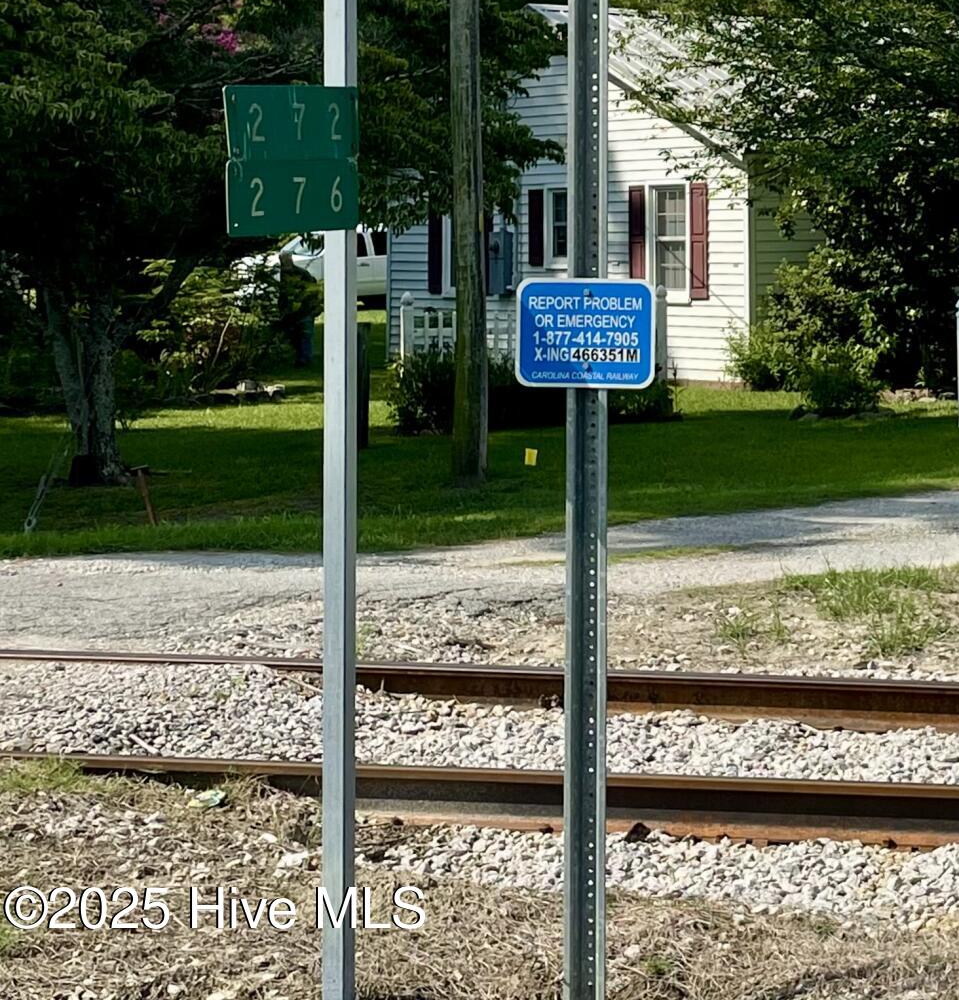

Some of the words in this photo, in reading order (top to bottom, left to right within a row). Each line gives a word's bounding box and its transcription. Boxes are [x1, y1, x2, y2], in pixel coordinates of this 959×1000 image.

[249, 102, 342, 142] 272
[250, 176, 343, 217] 276
[528, 296, 581, 310] REPORT
[583, 297, 642, 311] PROBLEM
[534, 314, 554, 328] OR
[557, 315, 635, 329] EMERGENCY
[533, 331, 639, 346] 1-877-414-7905
[531, 371, 570, 380] CAROLINA
[571, 371, 605, 381] COASTAL
[606, 372, 639, 381] RAILWAY
